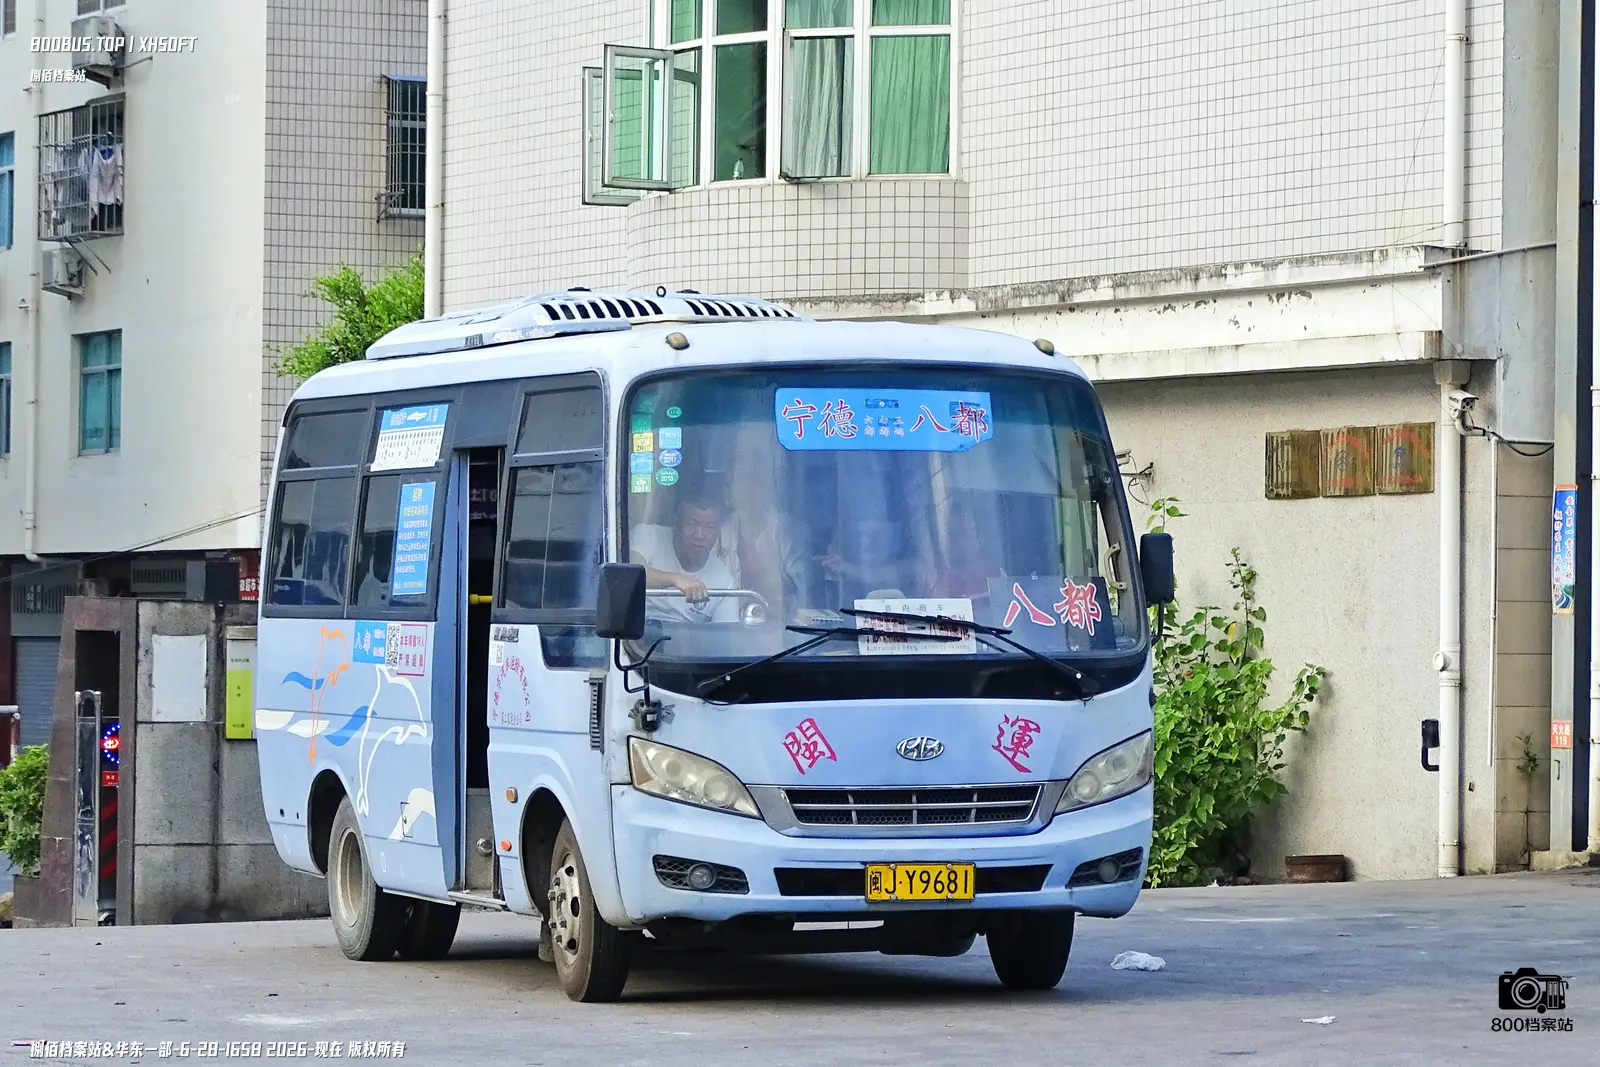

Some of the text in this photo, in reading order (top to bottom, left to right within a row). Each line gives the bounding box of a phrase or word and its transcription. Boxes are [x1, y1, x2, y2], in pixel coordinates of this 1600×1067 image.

[781, 397, 989, 442] 宁德 八都
[1003, 578, 1102, 637] 八都
[991, 713, 1041, 773] 運
[1555, 735, 1568, 746] 119
